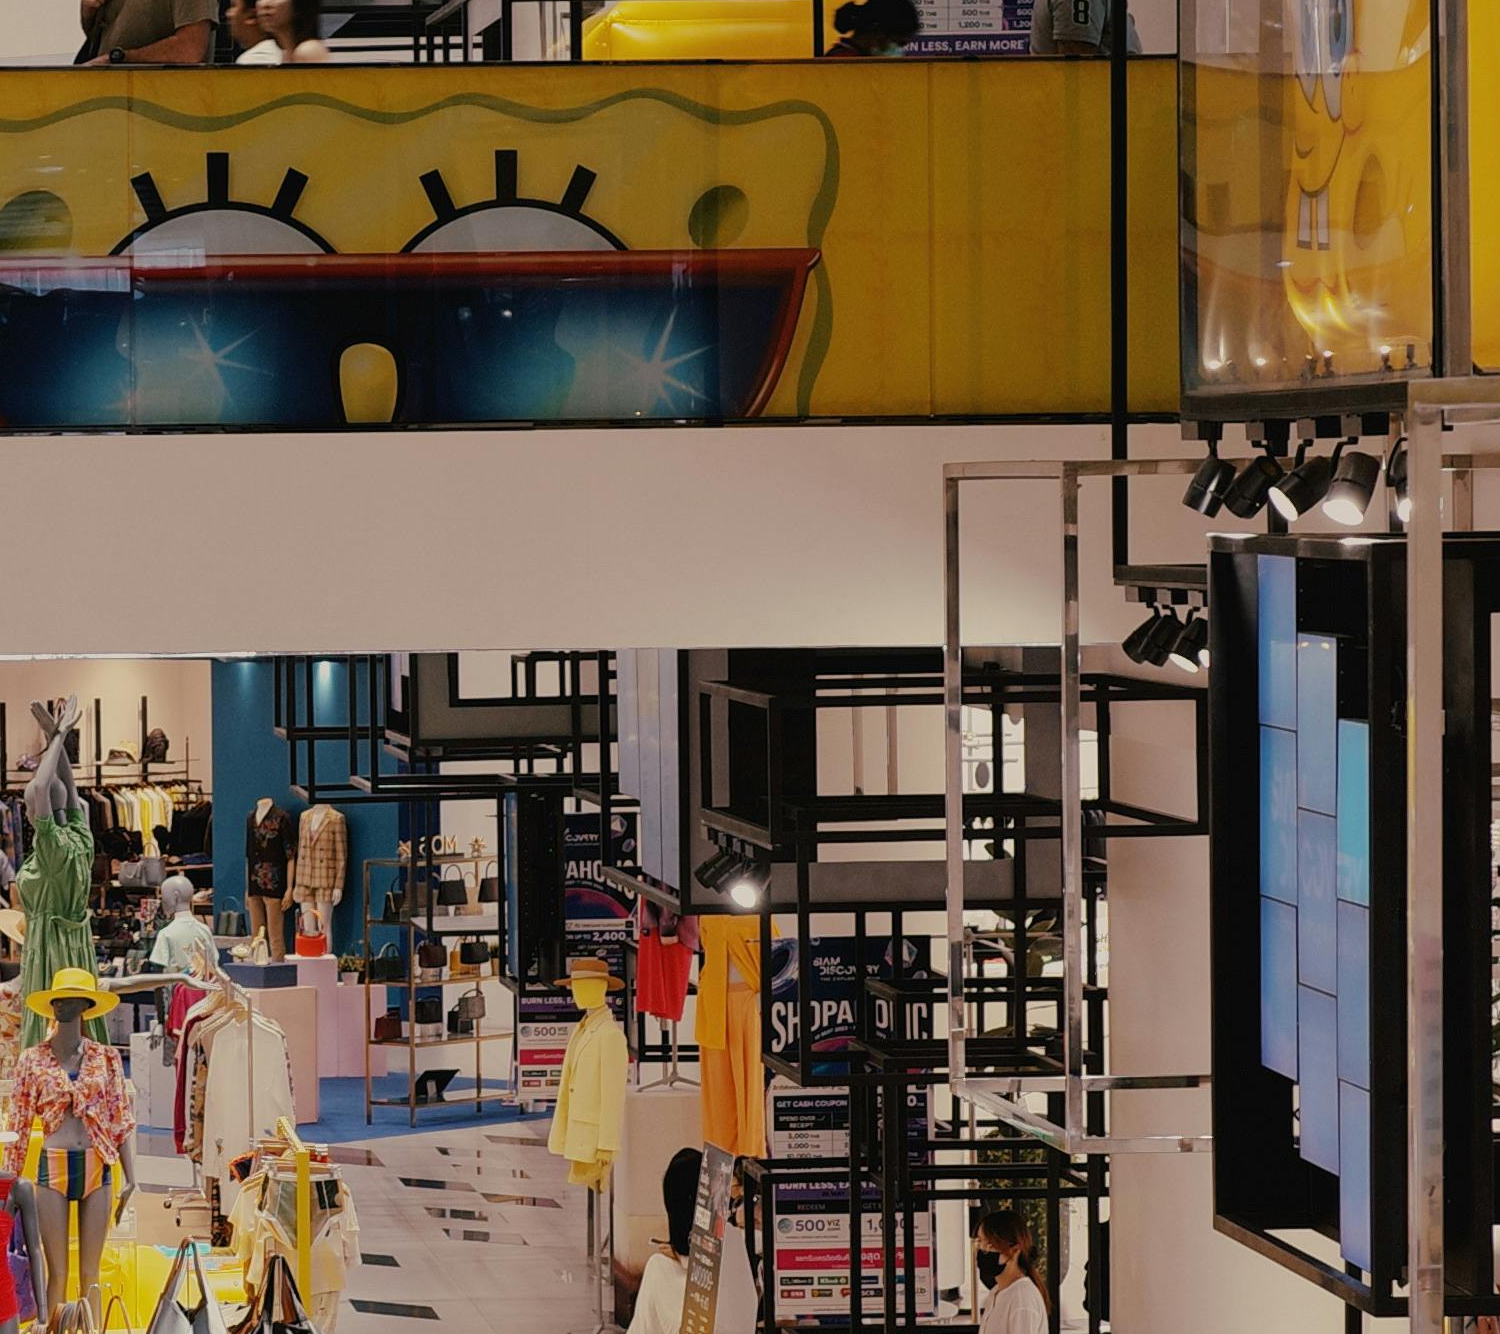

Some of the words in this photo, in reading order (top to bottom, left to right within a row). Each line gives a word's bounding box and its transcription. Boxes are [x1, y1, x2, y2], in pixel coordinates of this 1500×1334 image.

[921, 41, 953, 53] LESS,
[955, 40, 987, 51] EARN
[989, 39, 1025, 50] MORE
[592, 932, 627, 943] 2,400
[812, 957, 841, 967] SIAM
[520, 996, 543, 1004] BURN
[533, 1026, 557, 1036] 500
[776, 1100, 792, 1108] GET
[792, 1099, 814, 1108] CASH
[815, 1099, 848, 1107] COUPON
[795, 1219, 826, 1231] 500
[827, 1219, 841, 1227] VIZ
